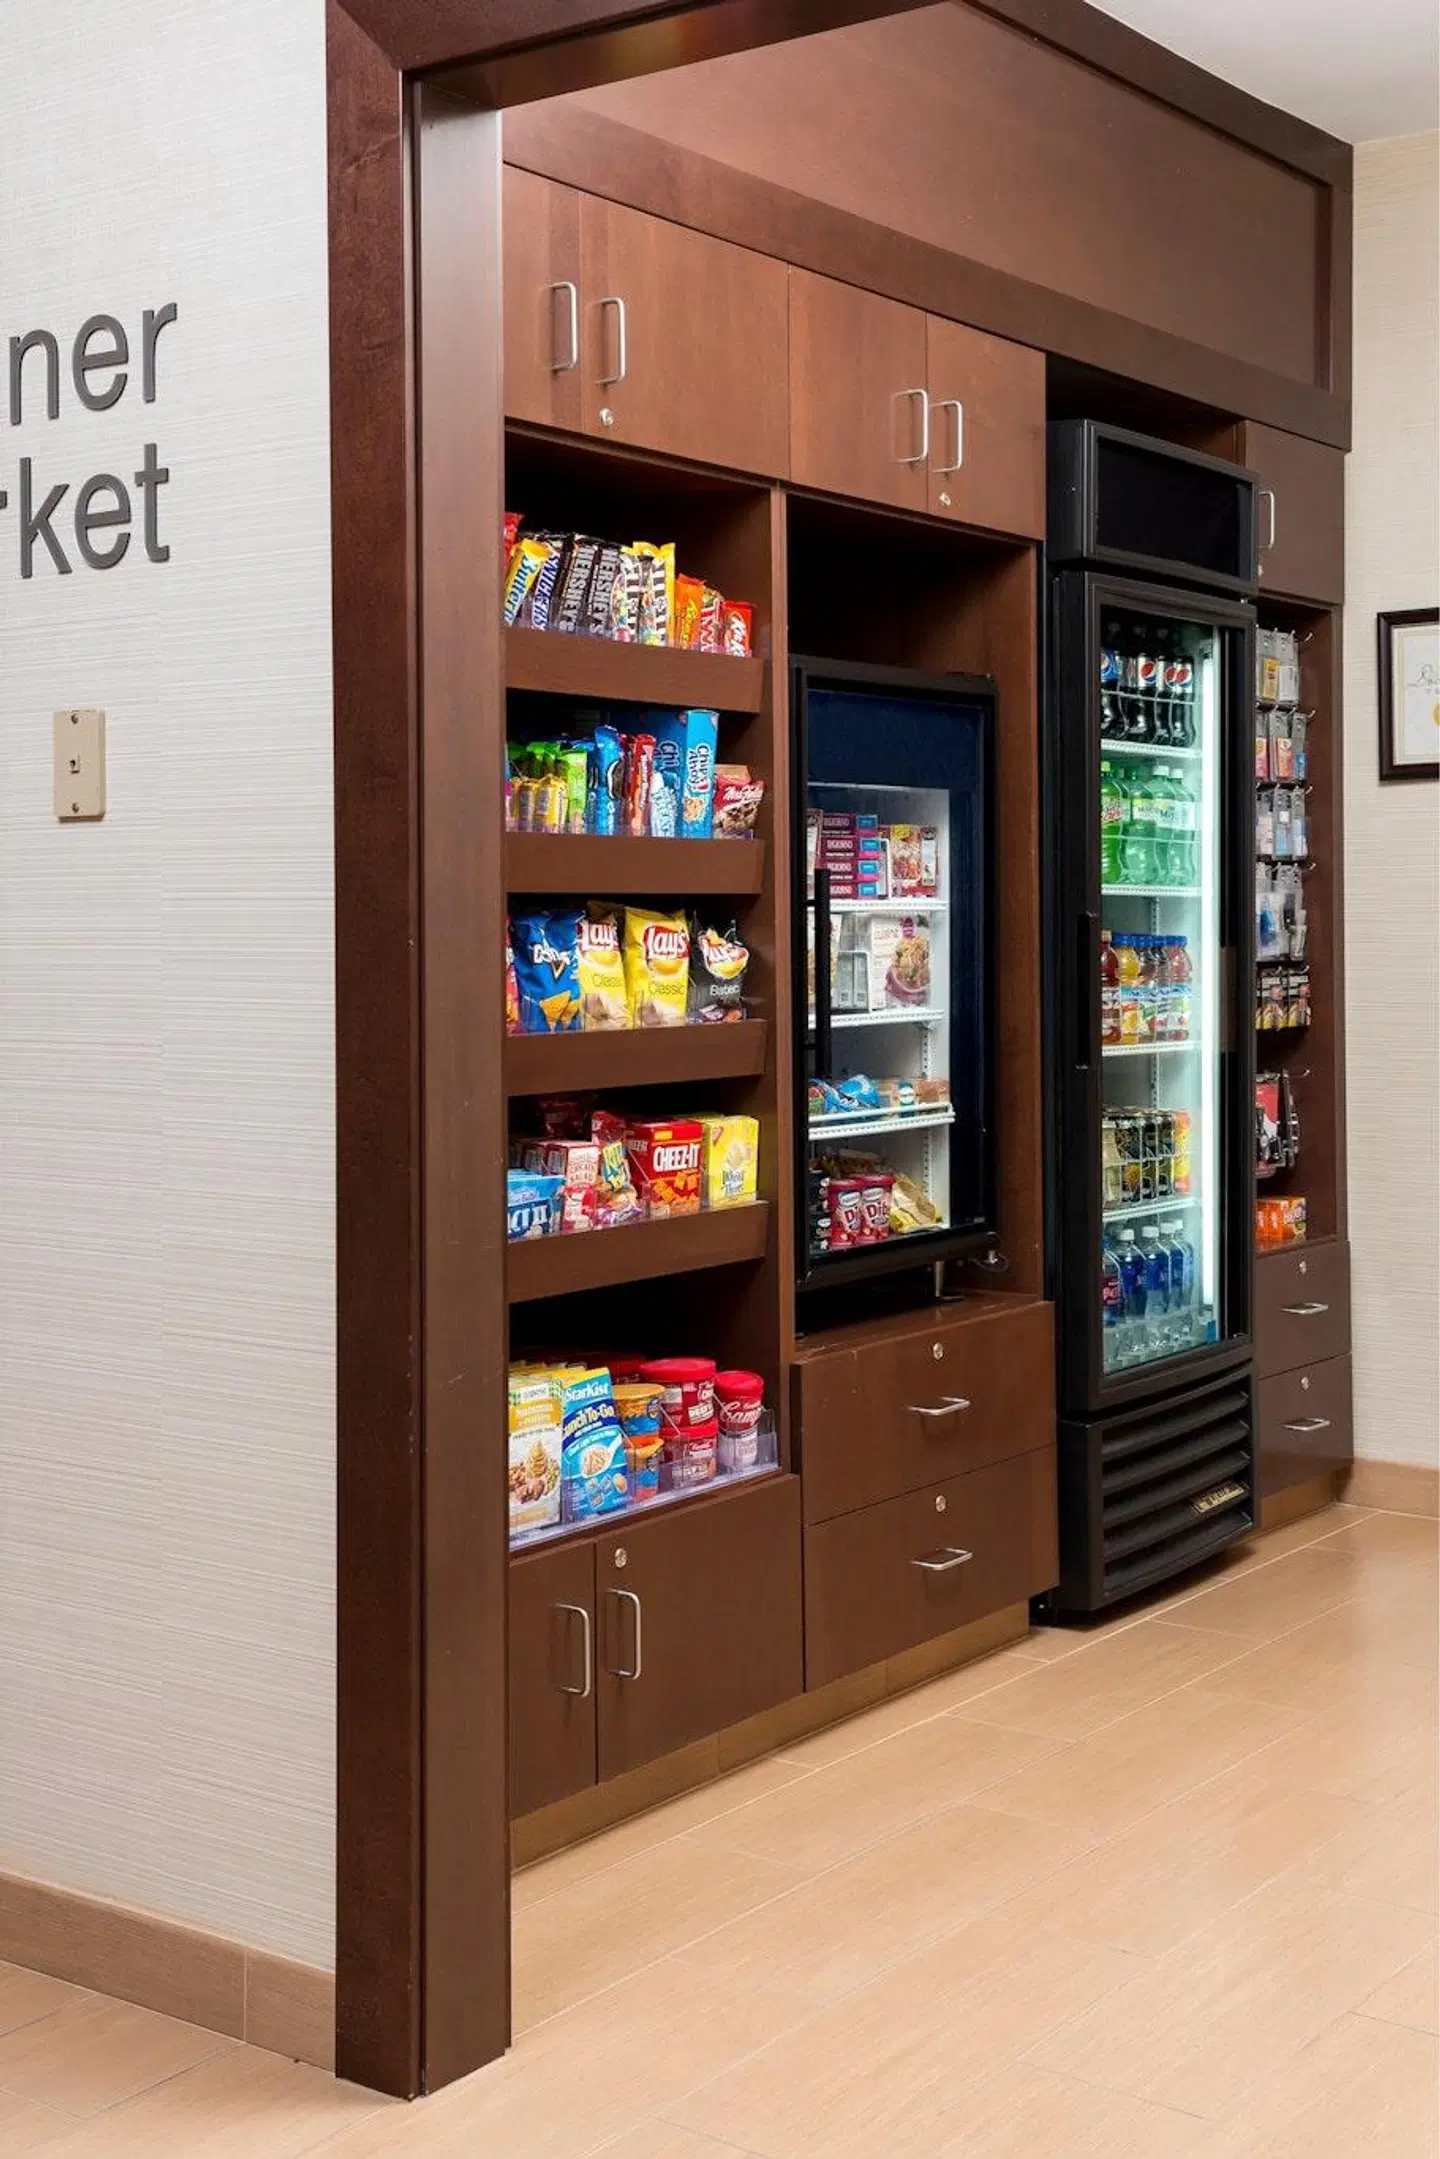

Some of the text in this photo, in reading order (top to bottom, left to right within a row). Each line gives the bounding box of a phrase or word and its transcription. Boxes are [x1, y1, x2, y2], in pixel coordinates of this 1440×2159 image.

[9, 301, 178, 426] ner
[0, 443, 170, 579] ket
[646, 926, 687, 959] Lay's
[649, 980, 686, 996] Classic
[653, 1143, 700, 1172] CHEEZ-IT
